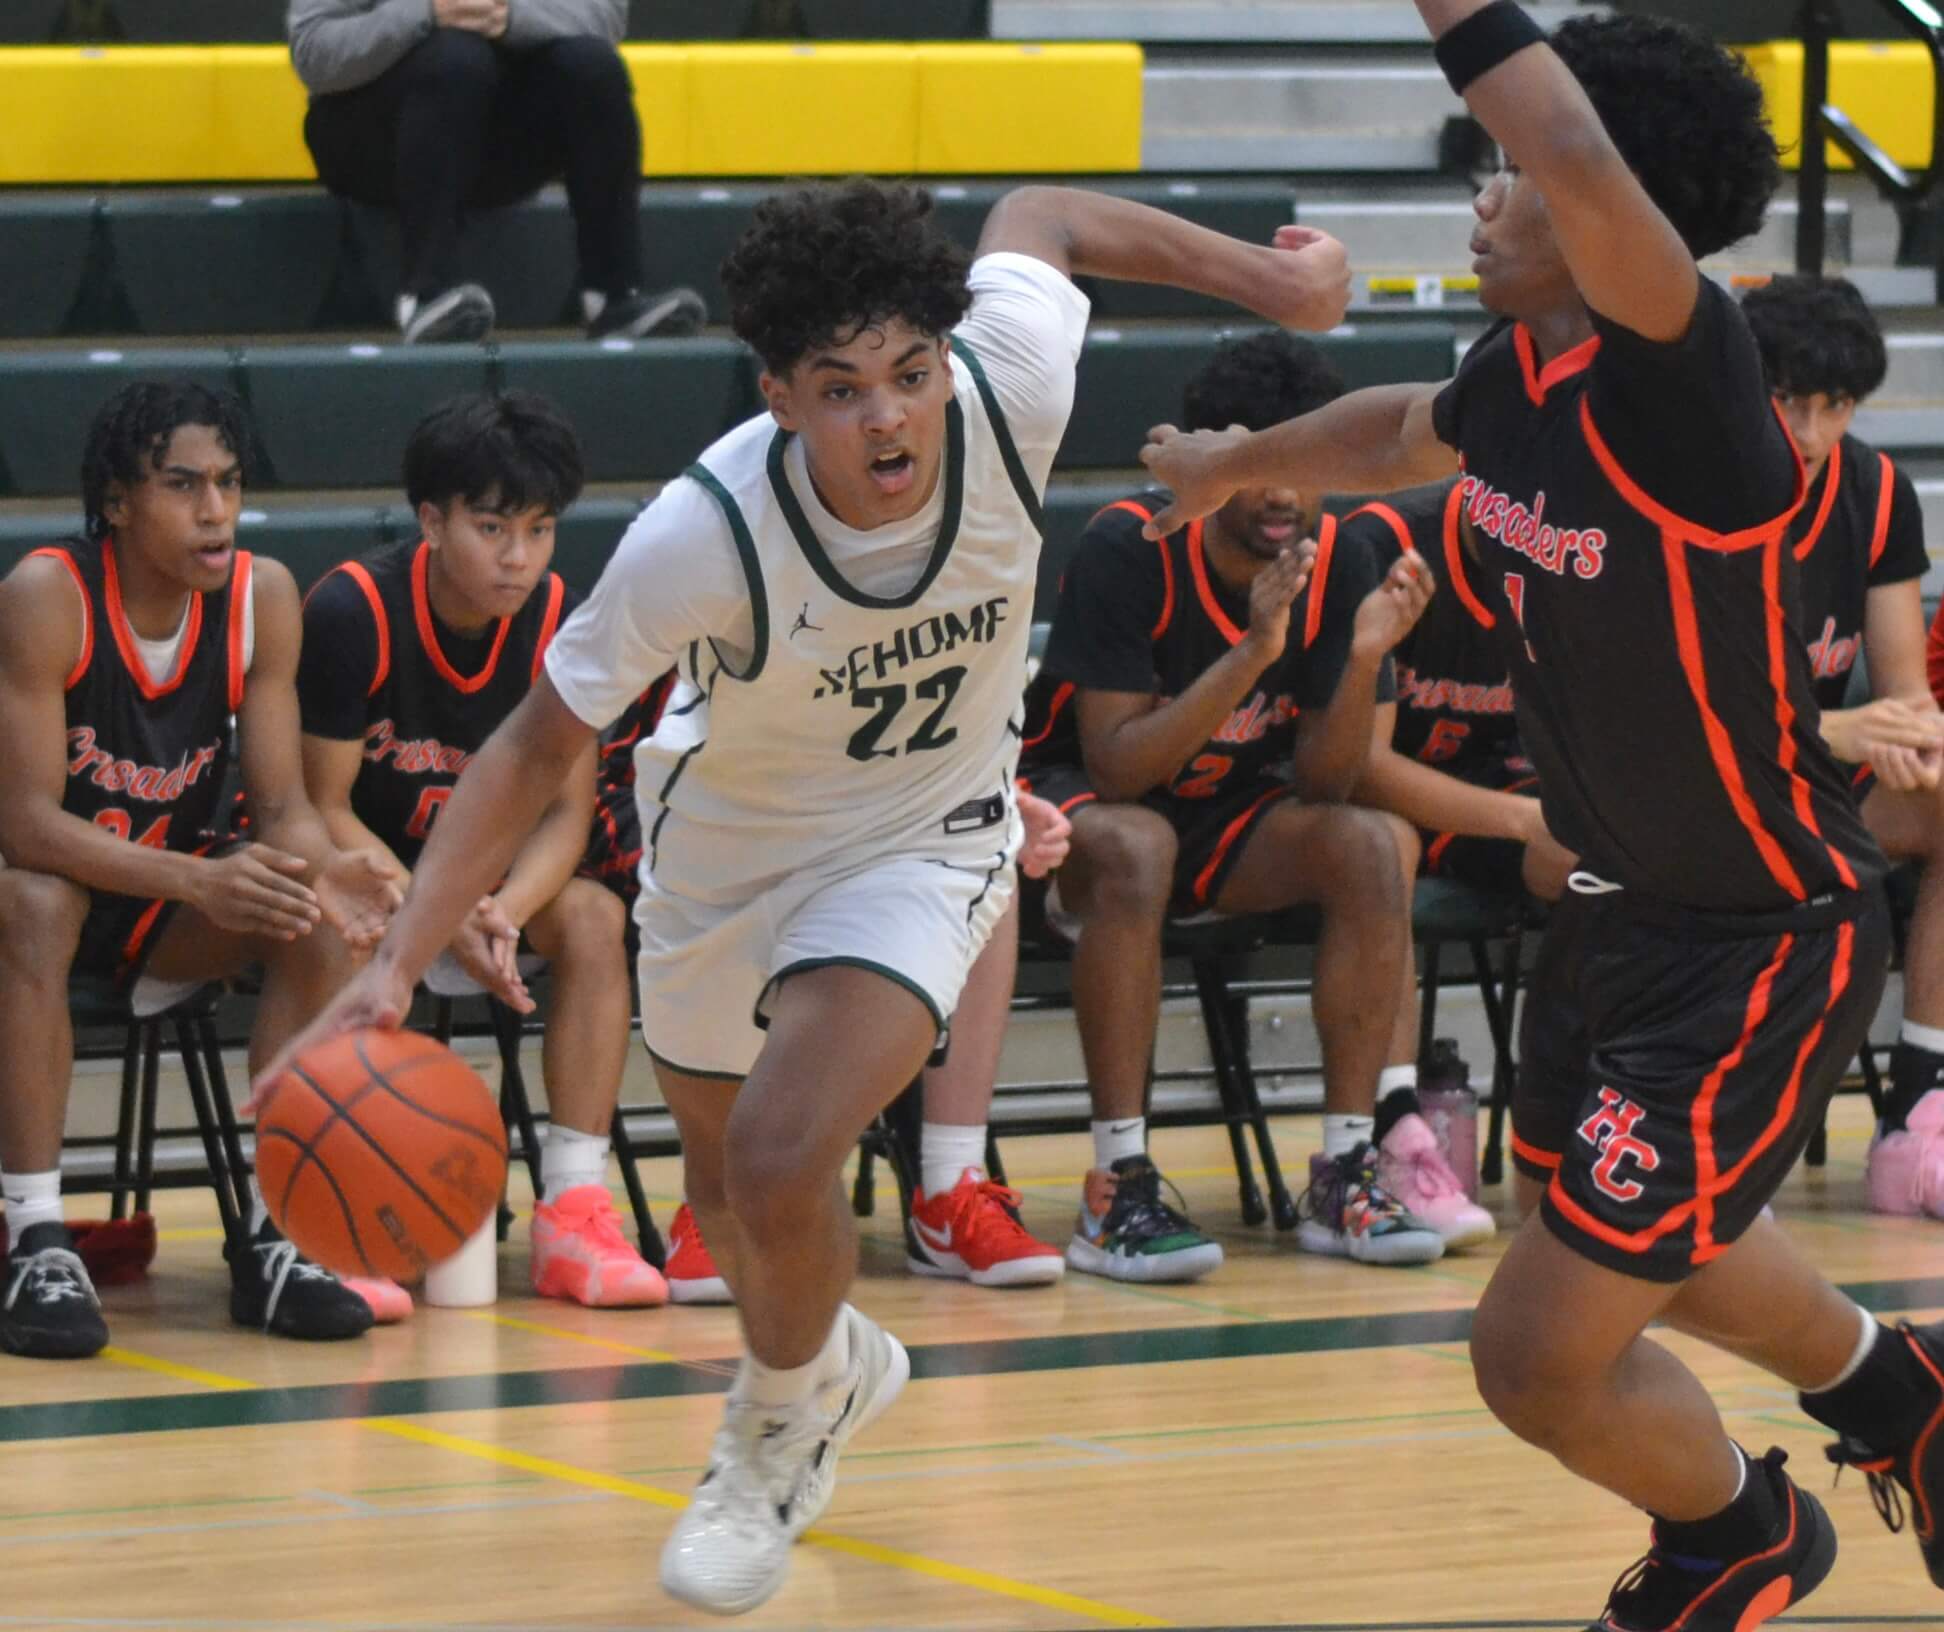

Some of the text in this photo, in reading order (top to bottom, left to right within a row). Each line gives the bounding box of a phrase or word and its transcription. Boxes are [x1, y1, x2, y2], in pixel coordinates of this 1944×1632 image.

[1458, 460, 1607, 579] rusaders
[846, 665, 968, 762] 22
[1175, 753, 1233, 797] 2
[1576, 1085, 1660, 1202] HC
